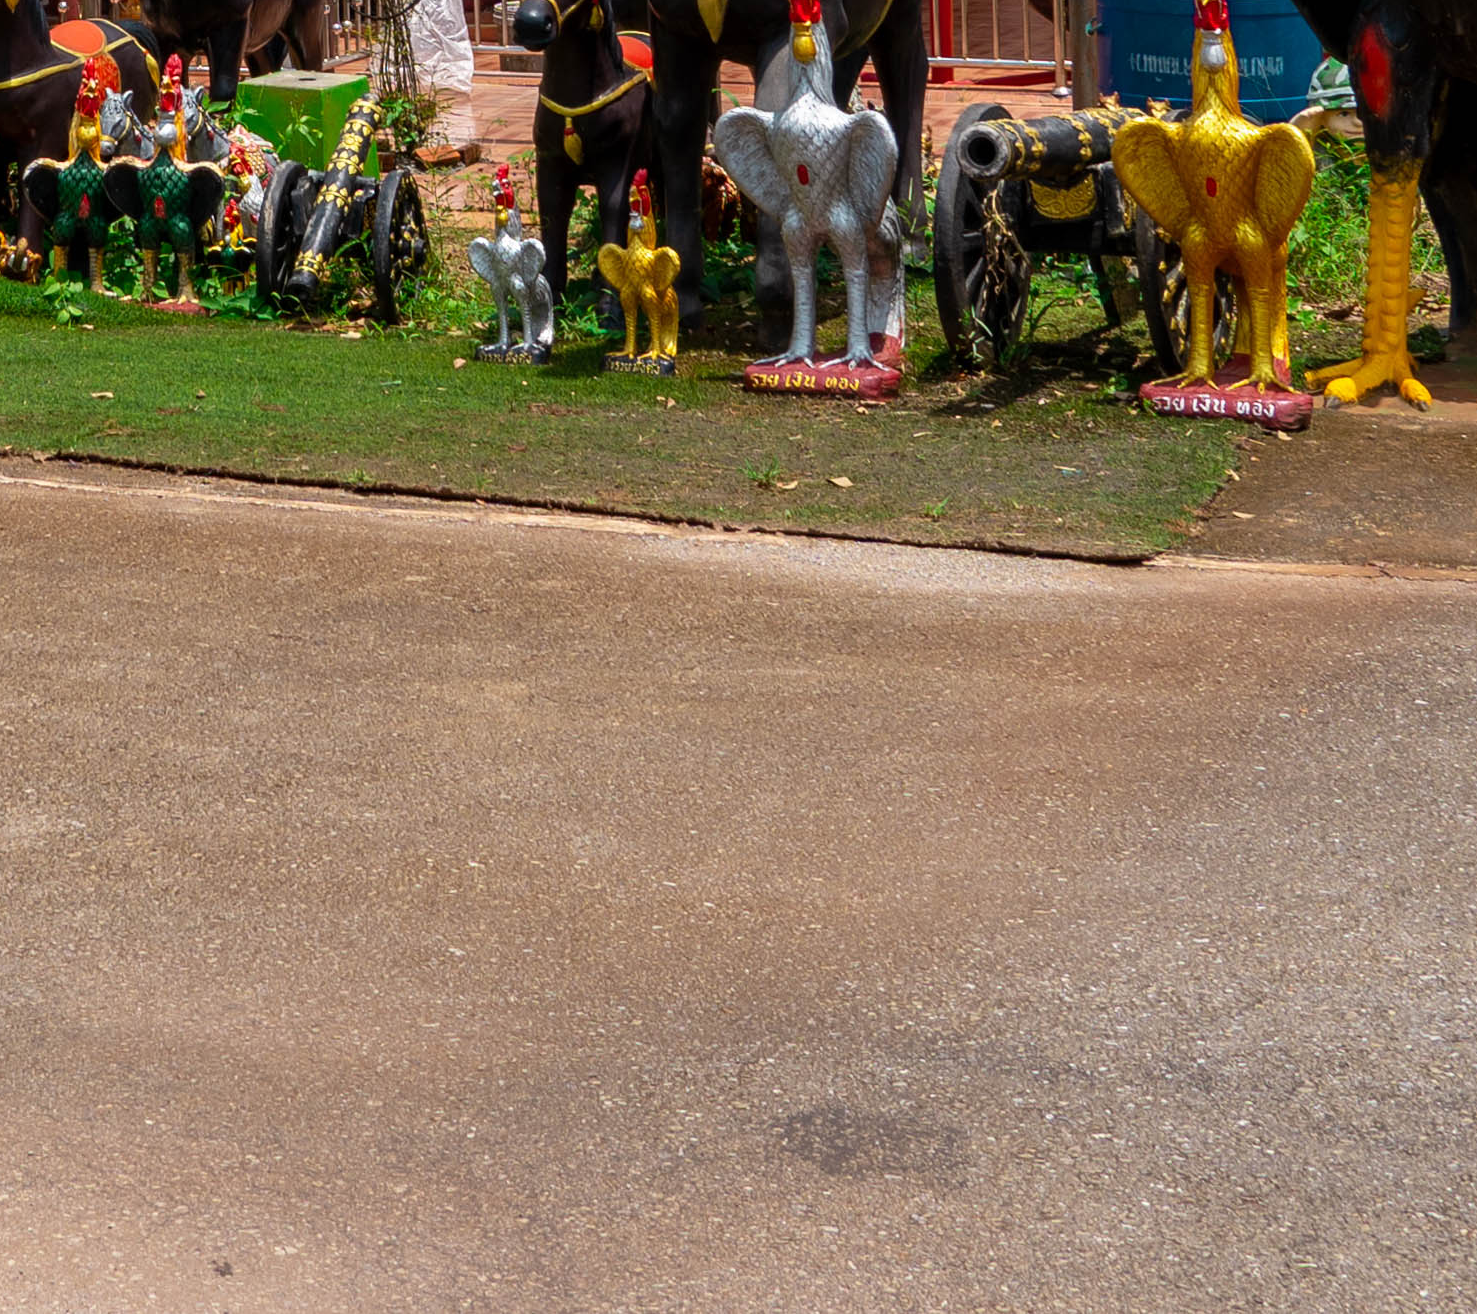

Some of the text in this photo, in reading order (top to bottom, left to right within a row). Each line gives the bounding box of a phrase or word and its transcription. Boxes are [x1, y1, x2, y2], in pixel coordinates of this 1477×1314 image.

[749, 371, 860, 391] รวย เงิน ทอง
[1152, 394, 1276, 418] รวย เงิน ทอง
